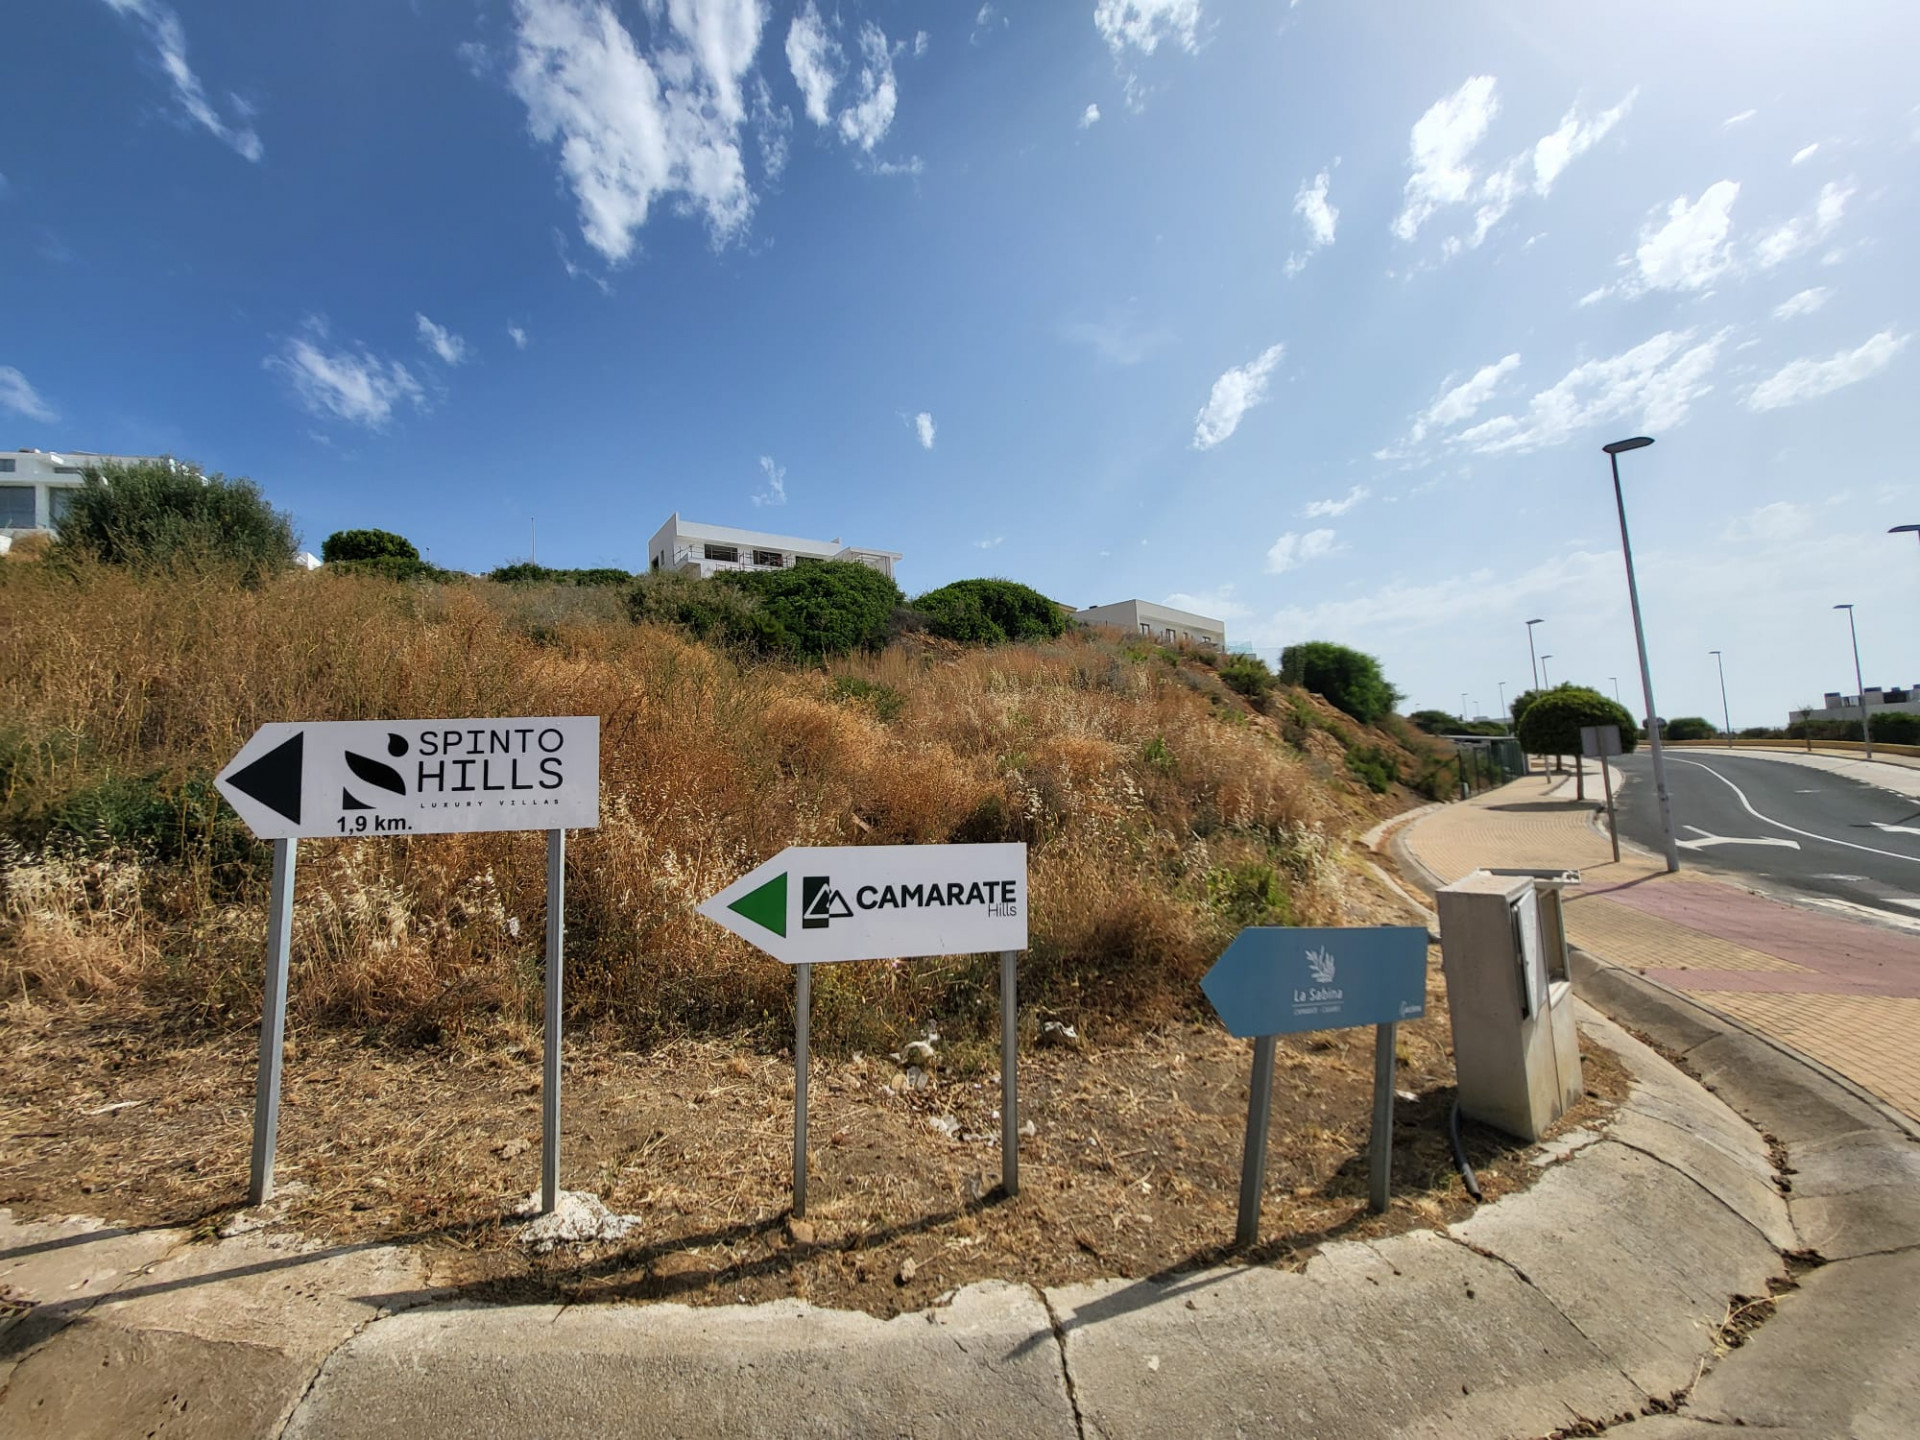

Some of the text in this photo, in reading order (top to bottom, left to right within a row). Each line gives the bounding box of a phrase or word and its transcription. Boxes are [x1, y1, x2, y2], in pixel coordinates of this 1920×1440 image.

[418, 728, 564, 756] SPINTO
[417, 757, 564, 793] HILLS
[420, 799, 559, 809] LUXURY VILLAS
[337, 814, 412, 835] 1,9 km.
[856, 880, 1017, 910] CAMARATE
[988, 902, 1017, 918] Hills
[1293, 988, 1307, 1002] La
